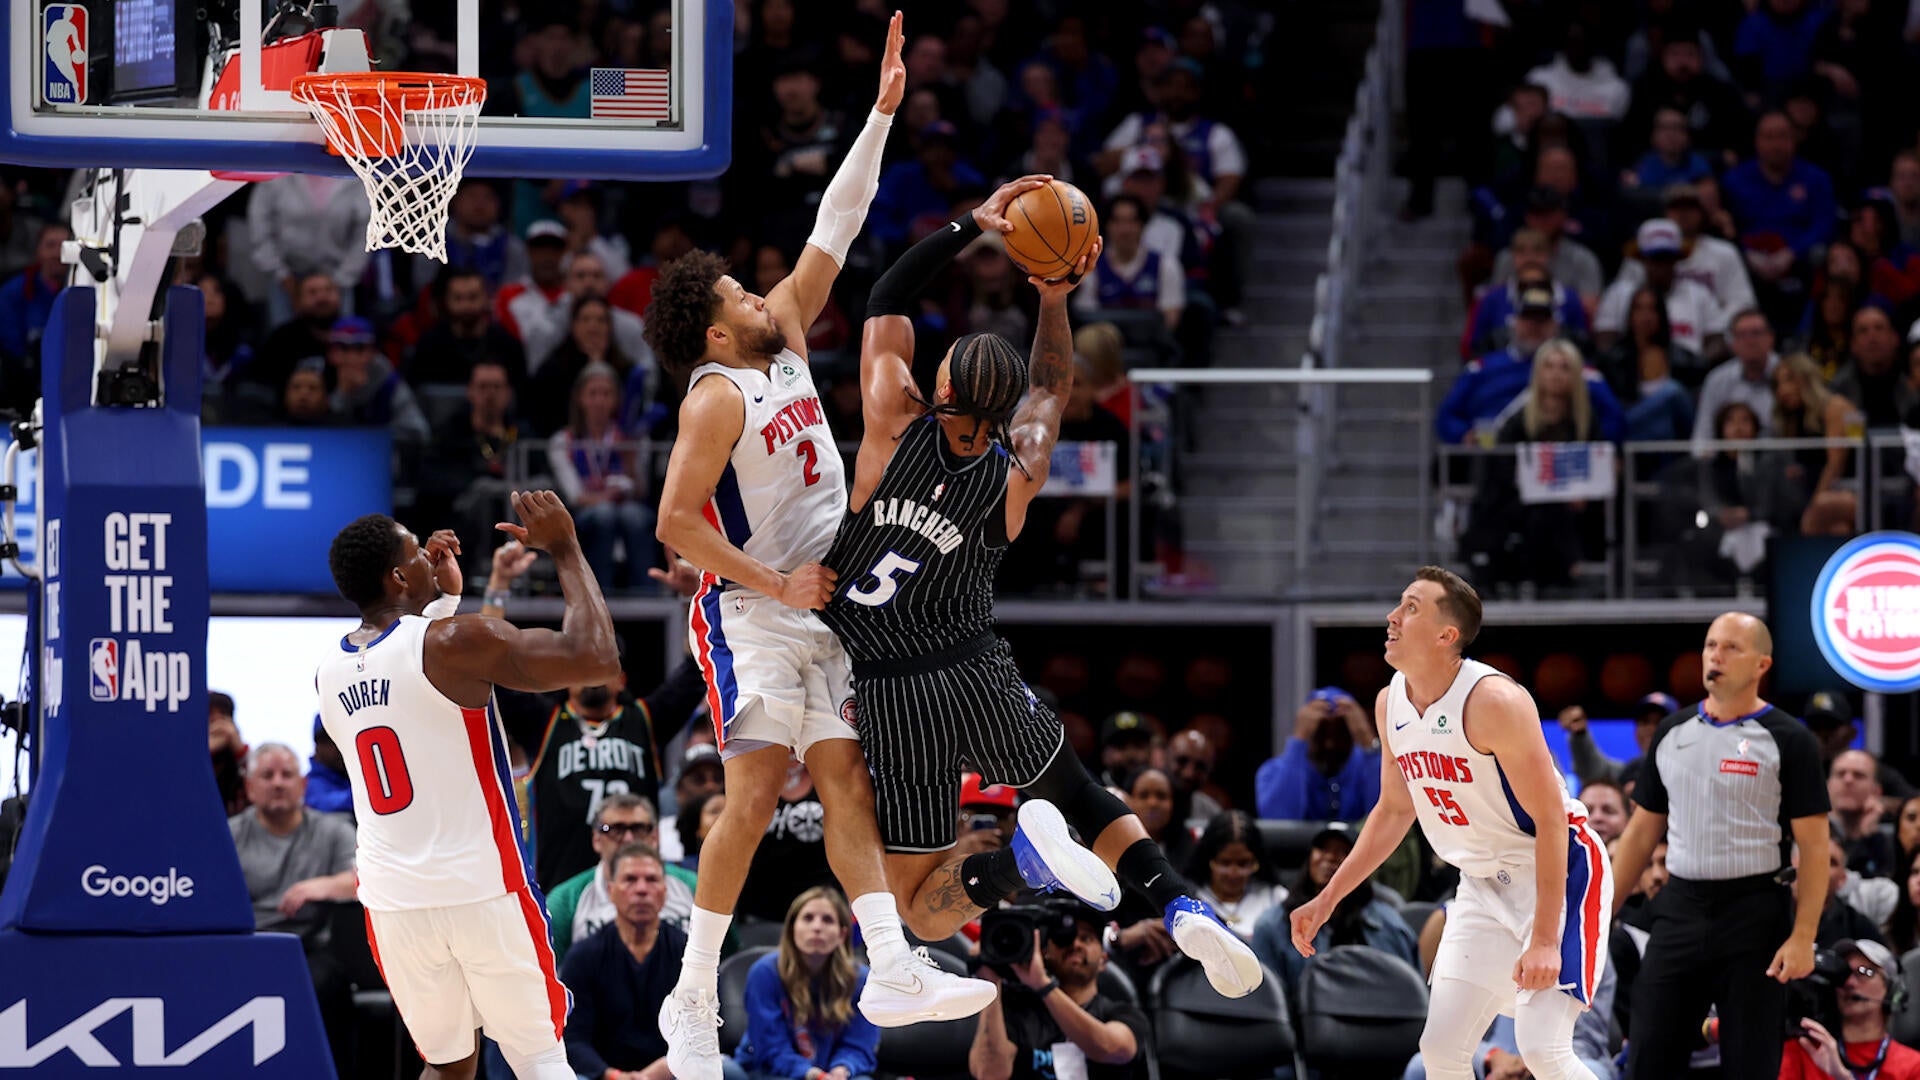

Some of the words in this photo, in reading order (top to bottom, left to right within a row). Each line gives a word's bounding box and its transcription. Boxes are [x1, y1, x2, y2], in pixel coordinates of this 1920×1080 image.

[50, 82, 71, 99] NBA
[760, 397, 823, 456] PISTONS
[796, 439, 821, 487] 2
[104, 511, 172, 571] GET
[873, 497, 964, 555] BANCHERO
[104, 575, 174, 634] THE
[844, 548, 924, 607] 5
[121, 639, 191, 713] App
[338, 679, 390, 716] DUREN
[355, 725, 414, 815] 0
[1397, 751, 1473, 783] PISTONS
[1423, 786, 1470, 826] 55
[82, 865, 194, 905] Google
